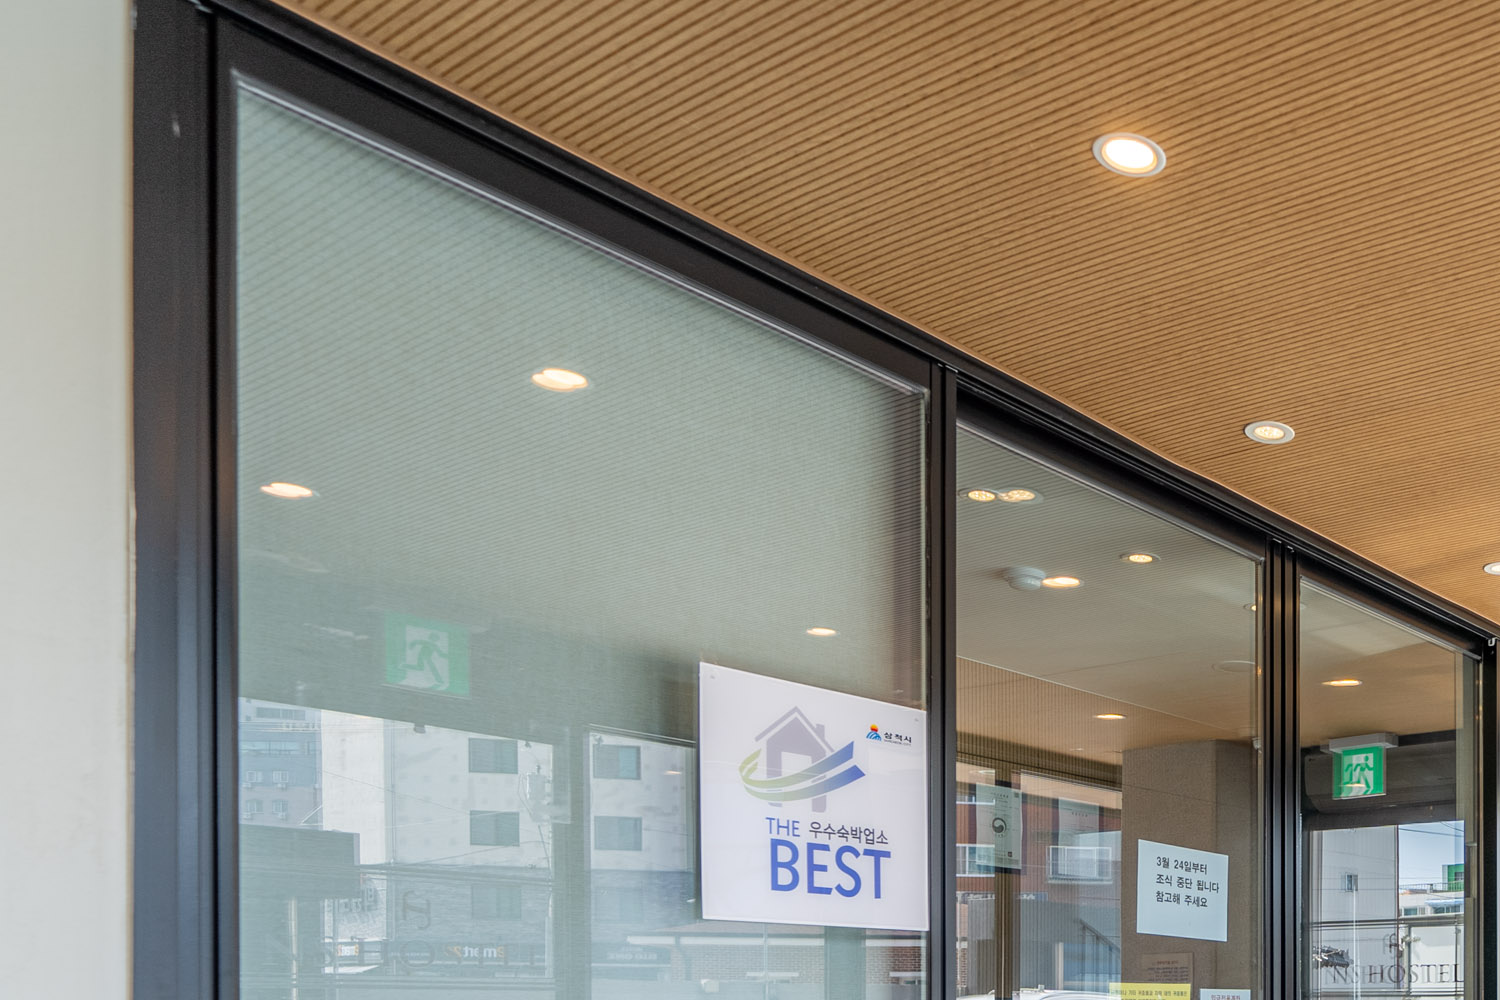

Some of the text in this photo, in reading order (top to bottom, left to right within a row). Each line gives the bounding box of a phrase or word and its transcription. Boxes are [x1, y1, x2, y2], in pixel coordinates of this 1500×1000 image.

[766, 817, 800, 837] THE
[809, 822, 888, 845] 우수숙박업소
[770, 838, 891, 899] BEST
[1157, 857, 1207, 874] 3월 24일부터
[1156, 874, 1219, 893] 조식 중단 됩니다
[1156, 891, 1207, 907] 참고해 주세요
[1368, 964, 1464, 983] HOSTEL
